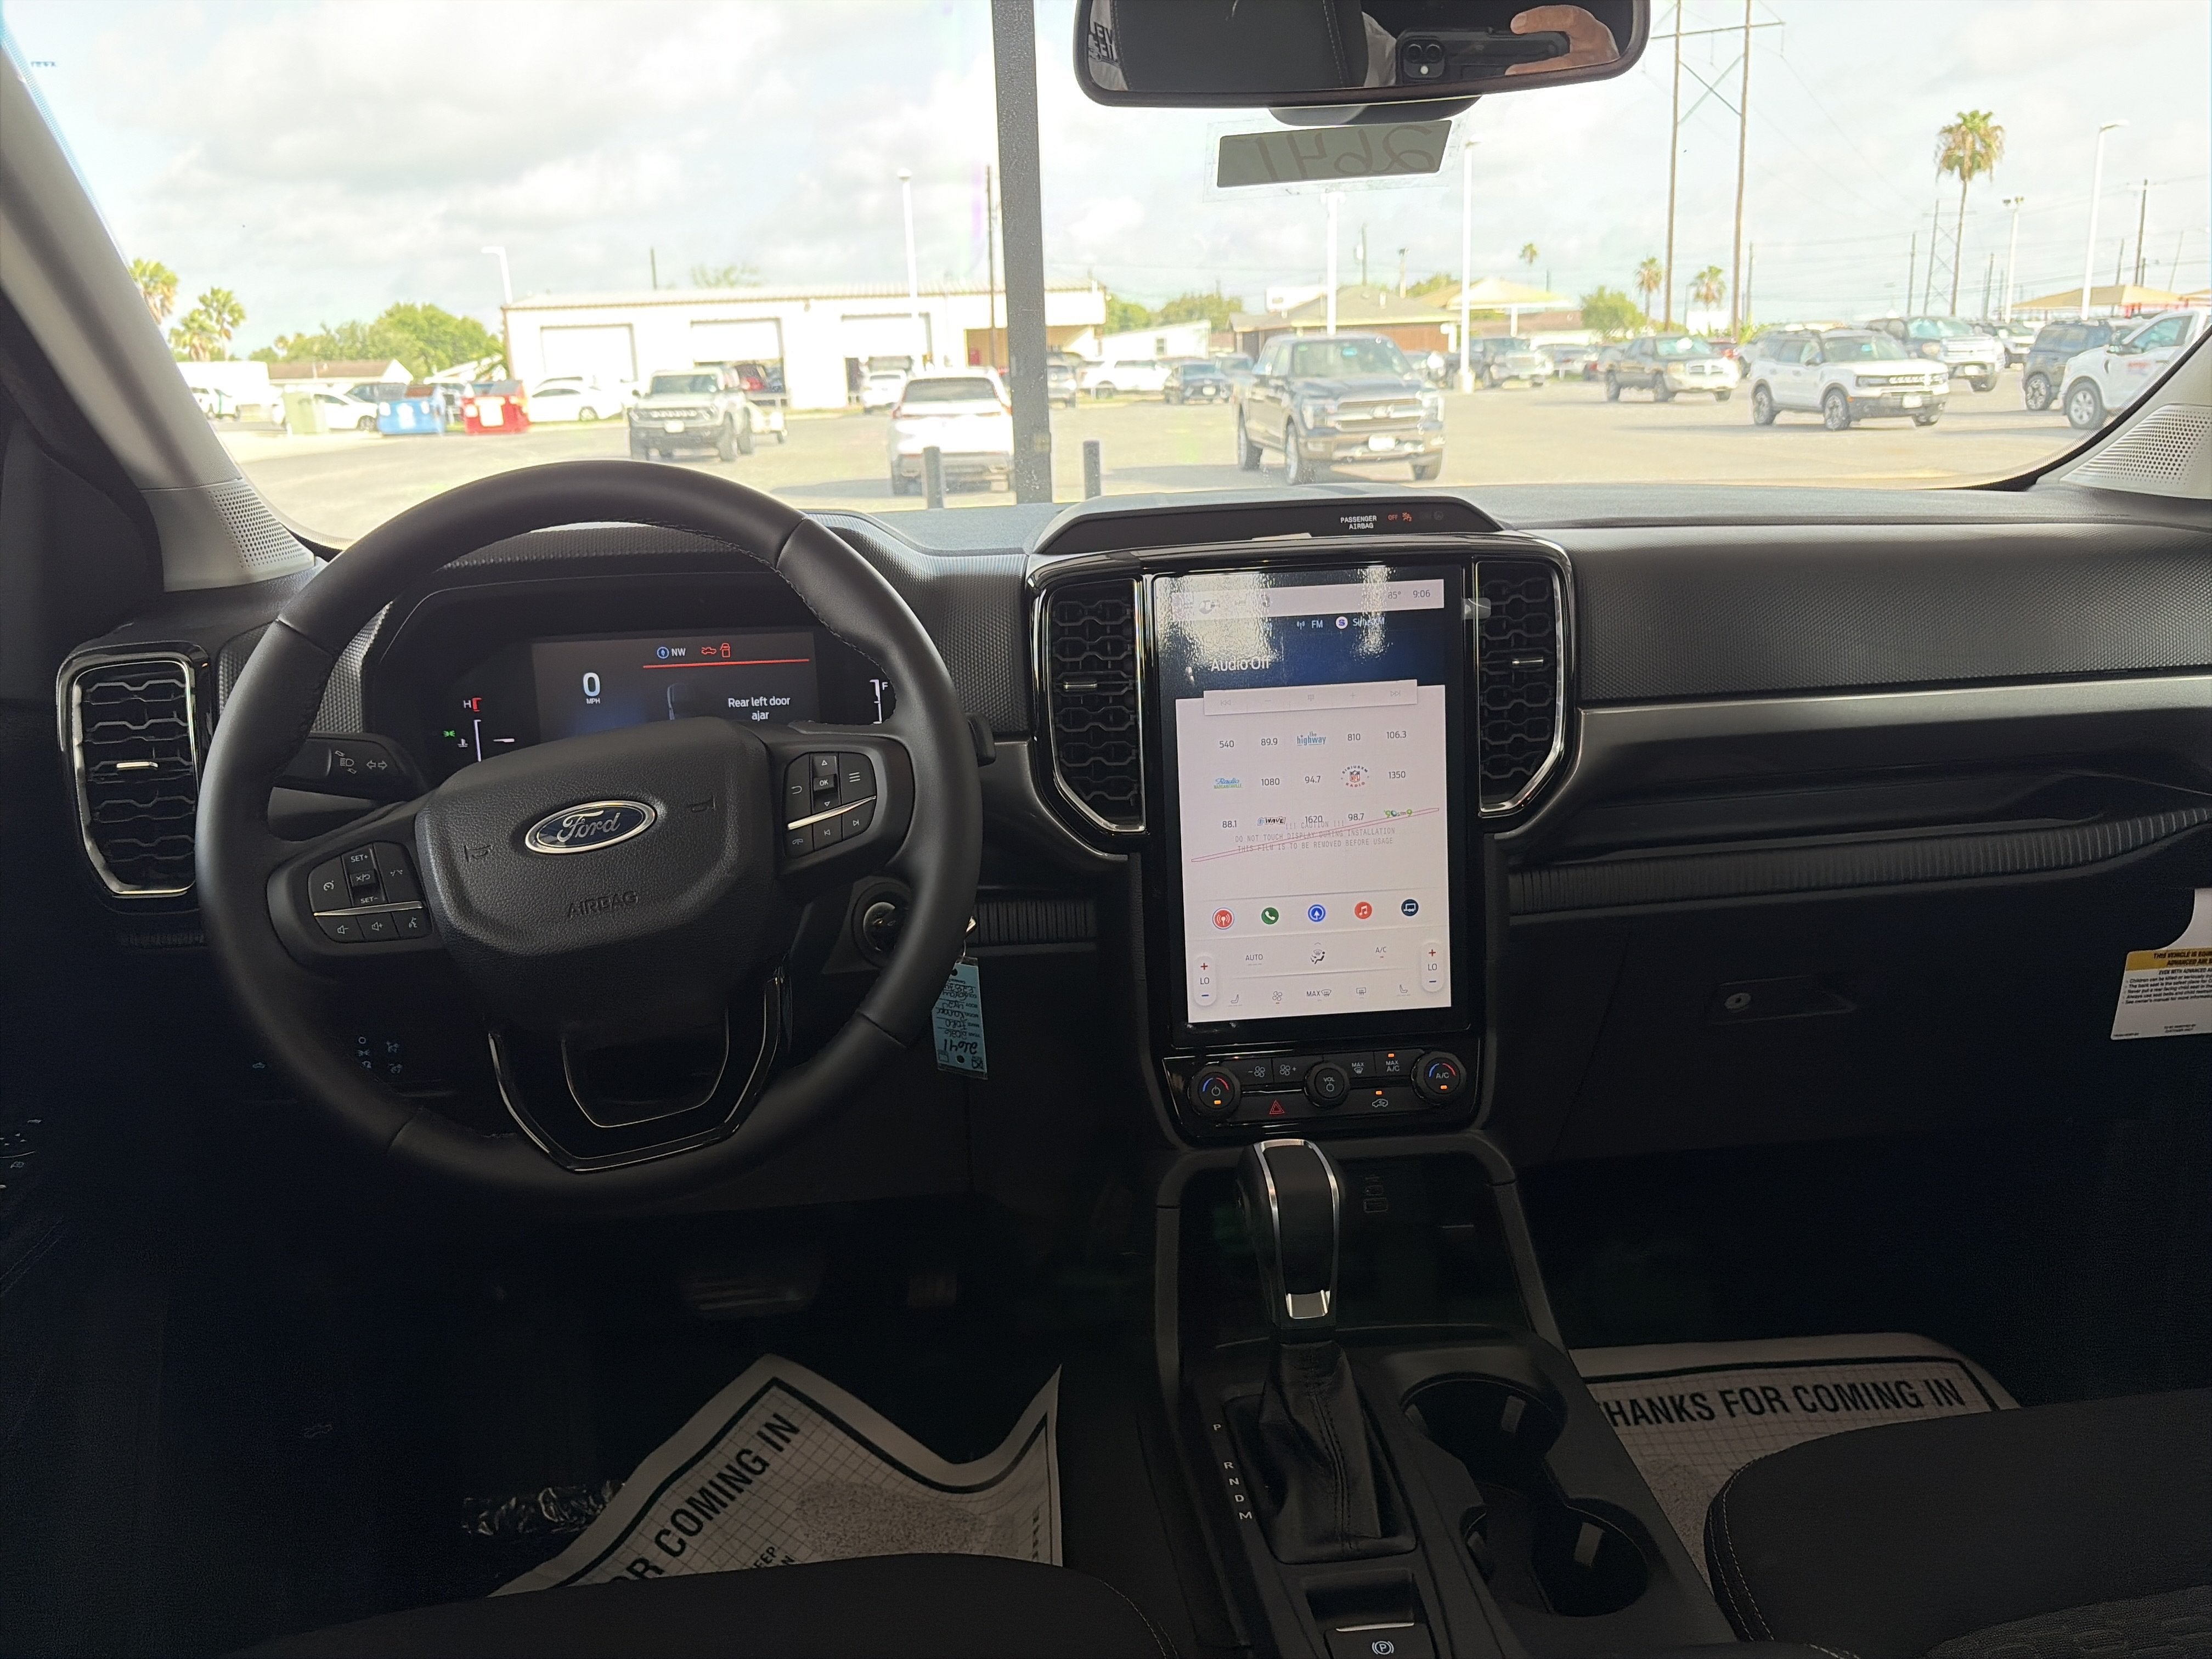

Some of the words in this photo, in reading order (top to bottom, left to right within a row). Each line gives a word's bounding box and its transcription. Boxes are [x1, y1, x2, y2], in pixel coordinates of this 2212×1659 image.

[1340, 515, 1377, 523] PASSENGER
[1413, 590, 1431, 598] 9:06
[1312, 620, 1323, 629] FM
[672, 648, 686, 657] NW
[1210, 659, 1249, 672] Audio
[583, 672, 601, 697] 0
[882, 682, 888, 691] F
[463, 700, 471, 709] H
[728, 698, 749, 708] Rear
[752, 696, 768, 706] left
[769, 696, 791, 706] door
[752, 711, 769, 722] ajar
[1347, 733, 1361, 741] 810
[1386, 730, 1407, 739] 106.3
[1219, 740, 1235, 748] 540
[1261, 738, 1278, 746] 89.9
[1296, 735, 1327, 746] highway
[1388, 770, 1406, 779] 1350
[1261, 777, 1280, 786] 1080
[1305, 775, 1321, 784] 94.7
[1305, 815, 1323, 823] 1620
[1348, 813, 1364, 821] 98.7
[557, 810, 621, 843] Ford
[1222, 820, 1237, 828] 88.1
[1301, 820, 1329, 829] CAUTION
[1287, 831, 1316, 839] DISPLAY
[1319, 830, 1344, 838] DURING
[1347, 827, 1395, 837] INSTALLATION
[1313, 840, 1341, 848] REMOVED
[1345, 838, 1369, 847] BEFORE
[566, 890, 639, 918] AIRBAG
[944, 1039, 978, 1054] 2641
[1598, 1390, 1716, 1427] HANKS
[1718, 1386, 1790, 1418] FOR
[1792, 1379, 1922, 1414] COMING
[1924, 1378, 1966, 1407] IN
[1213, 1423, 1221, 1431] P
[654, 1448, 770, 1558] COMING
[757, 1413, 800, 1452] IN
[1229, 1477, 1239, 1486] N
[1234, 1494, 1245, 1503] D
[1239, 1511, 1252, 1520] M
